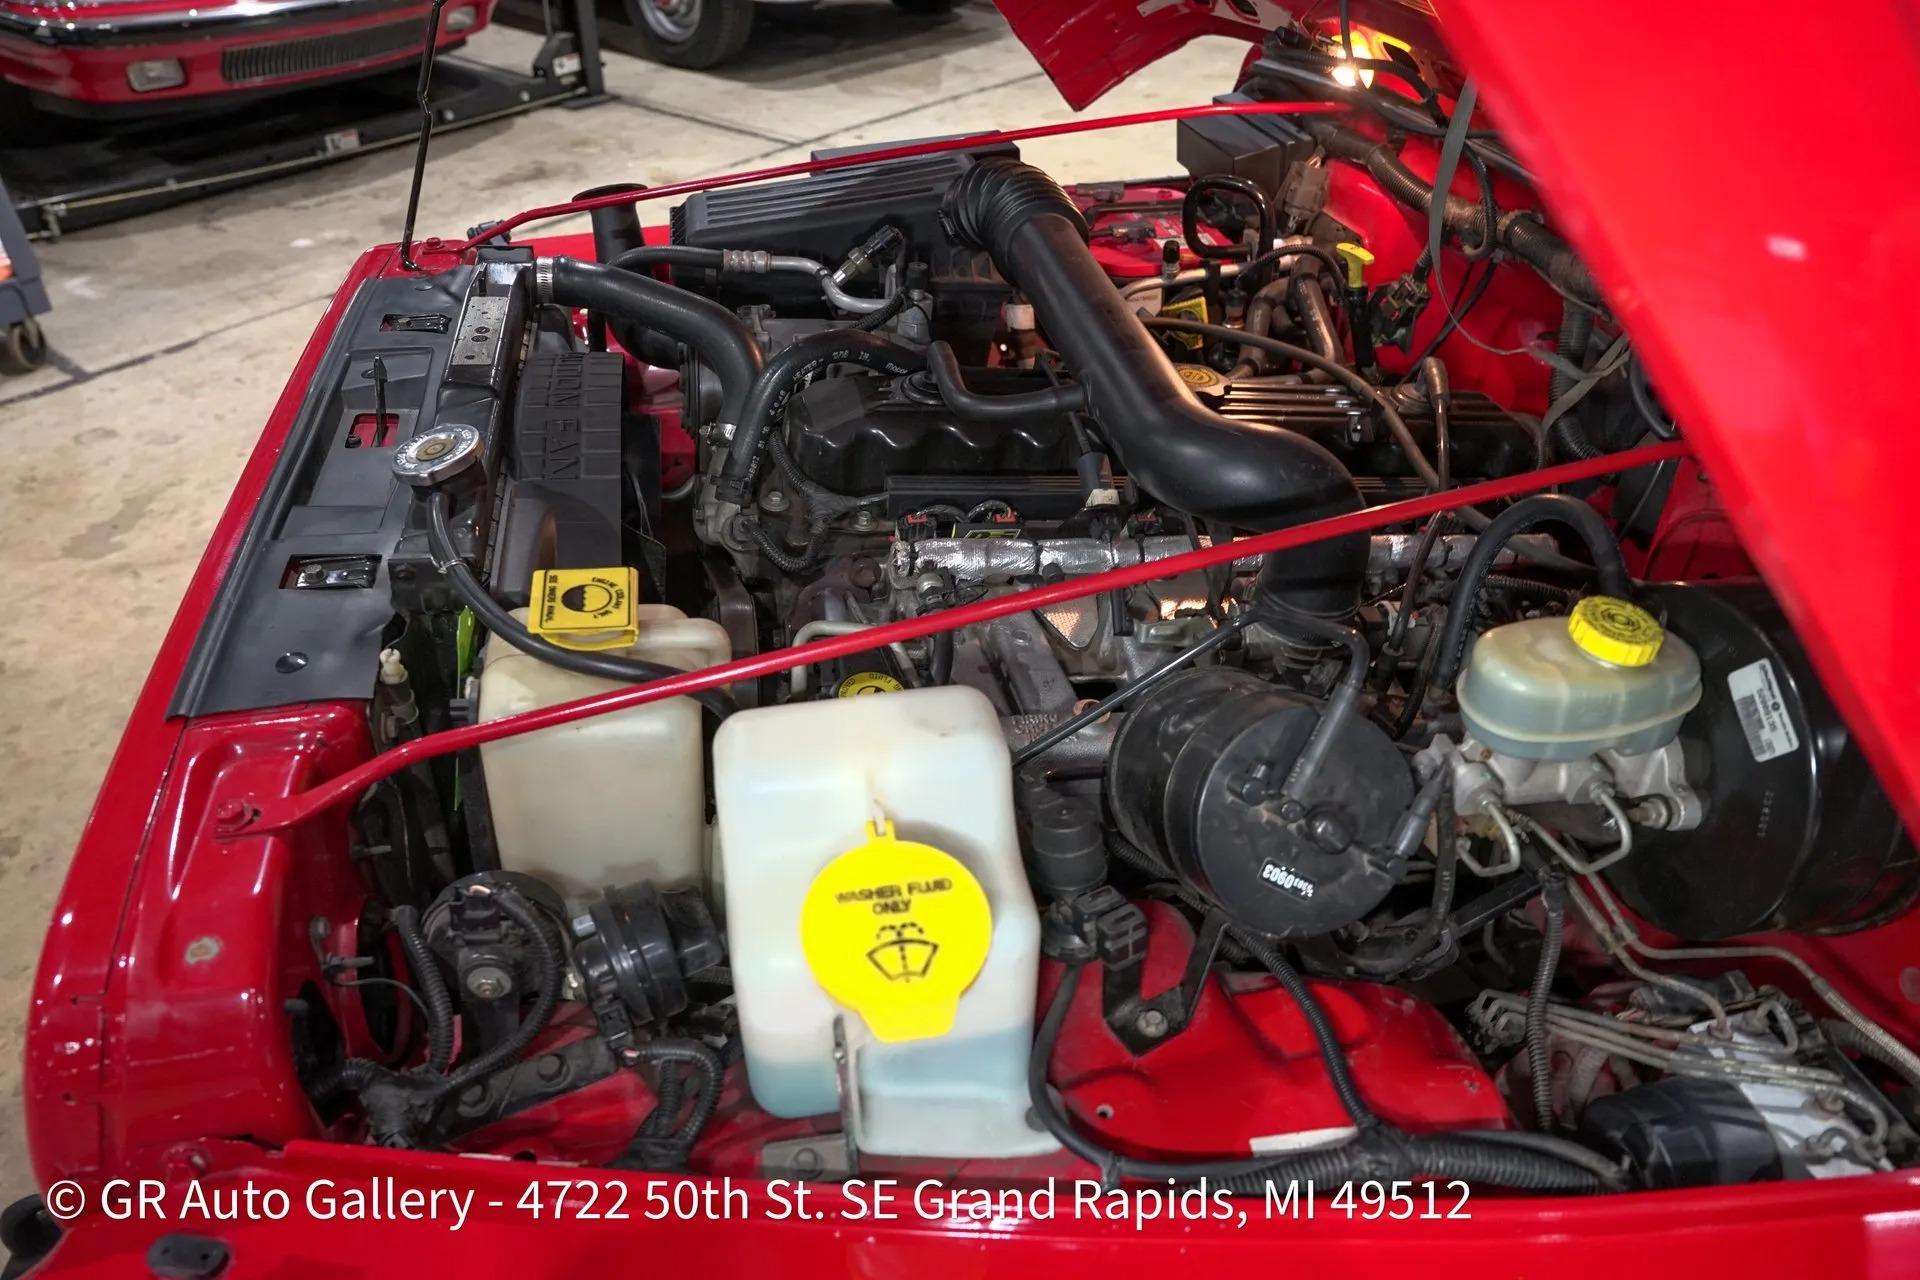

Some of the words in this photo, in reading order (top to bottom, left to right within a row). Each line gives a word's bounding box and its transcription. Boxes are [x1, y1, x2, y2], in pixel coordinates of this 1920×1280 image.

[548, 416, 581, 480] FAN
[835, 885, 902, 904] WASHER
[907, 878, 953, 896] FLUID
[872, 899, 911, 915] ONLY
